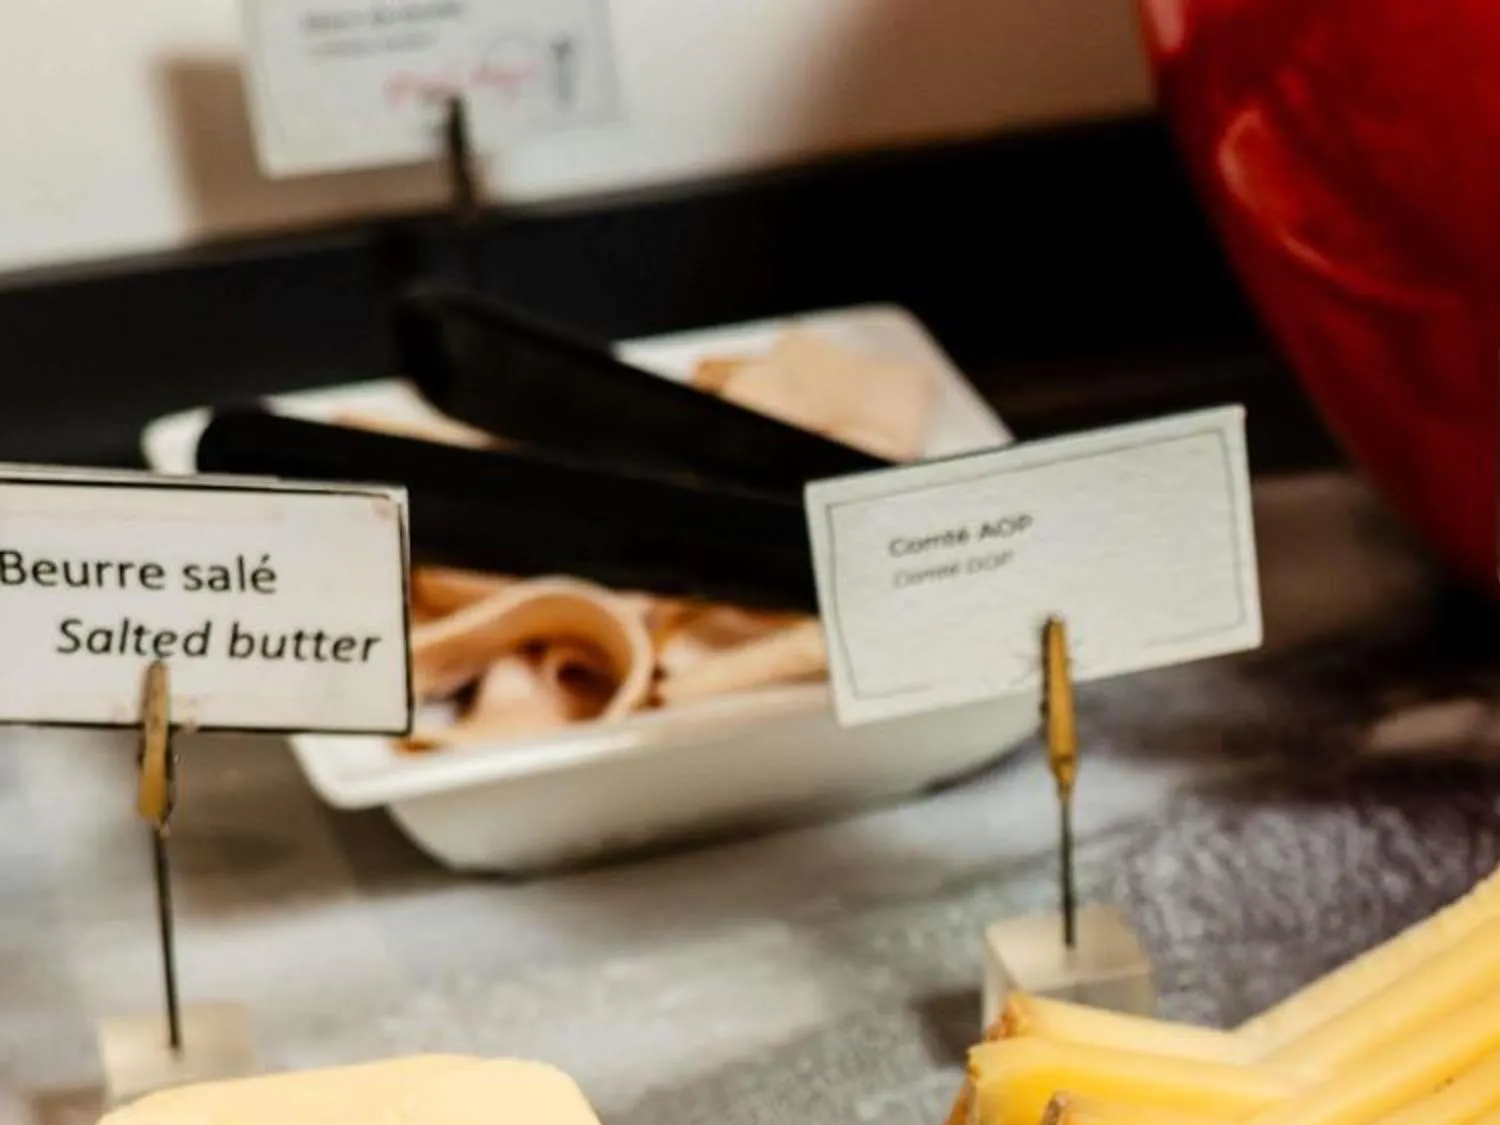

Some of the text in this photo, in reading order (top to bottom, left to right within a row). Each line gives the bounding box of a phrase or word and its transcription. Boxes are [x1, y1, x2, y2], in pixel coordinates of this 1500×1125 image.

[979, 513, 1034, 542] AOP
[0, 549, 278, 594] Beurre salé
[56, 616, 382, 663] Salted butter
